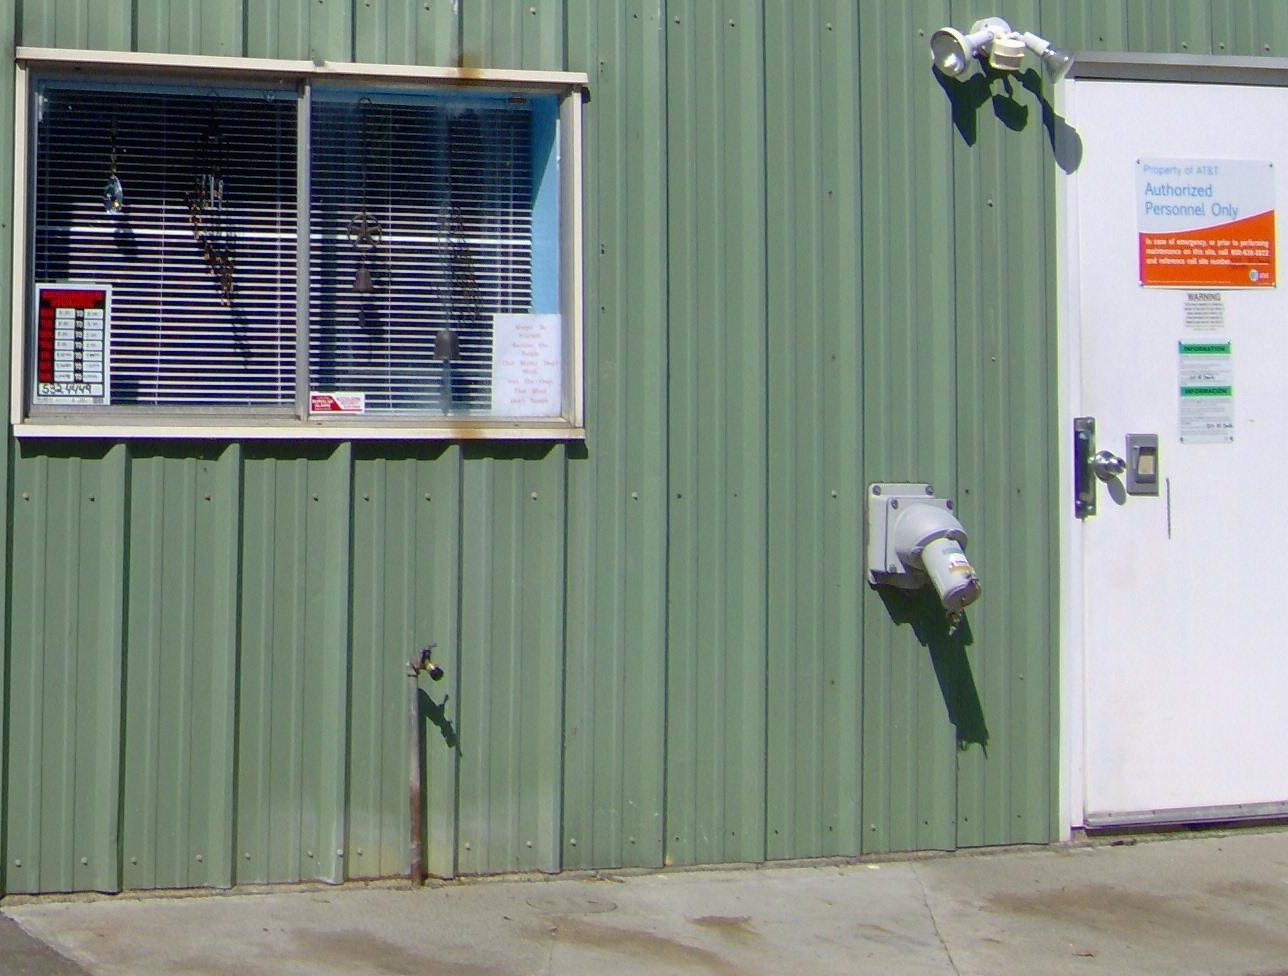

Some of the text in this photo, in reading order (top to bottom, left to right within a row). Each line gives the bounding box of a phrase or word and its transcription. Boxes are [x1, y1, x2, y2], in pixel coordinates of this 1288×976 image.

[1143, 165, 1219, 177] Property of AT&T
[1145, 183, 1213, 197] Authorized
[1145, 202, 1238, 219] Personnel Only
[1187, 293, 1221, 301] WARNING
